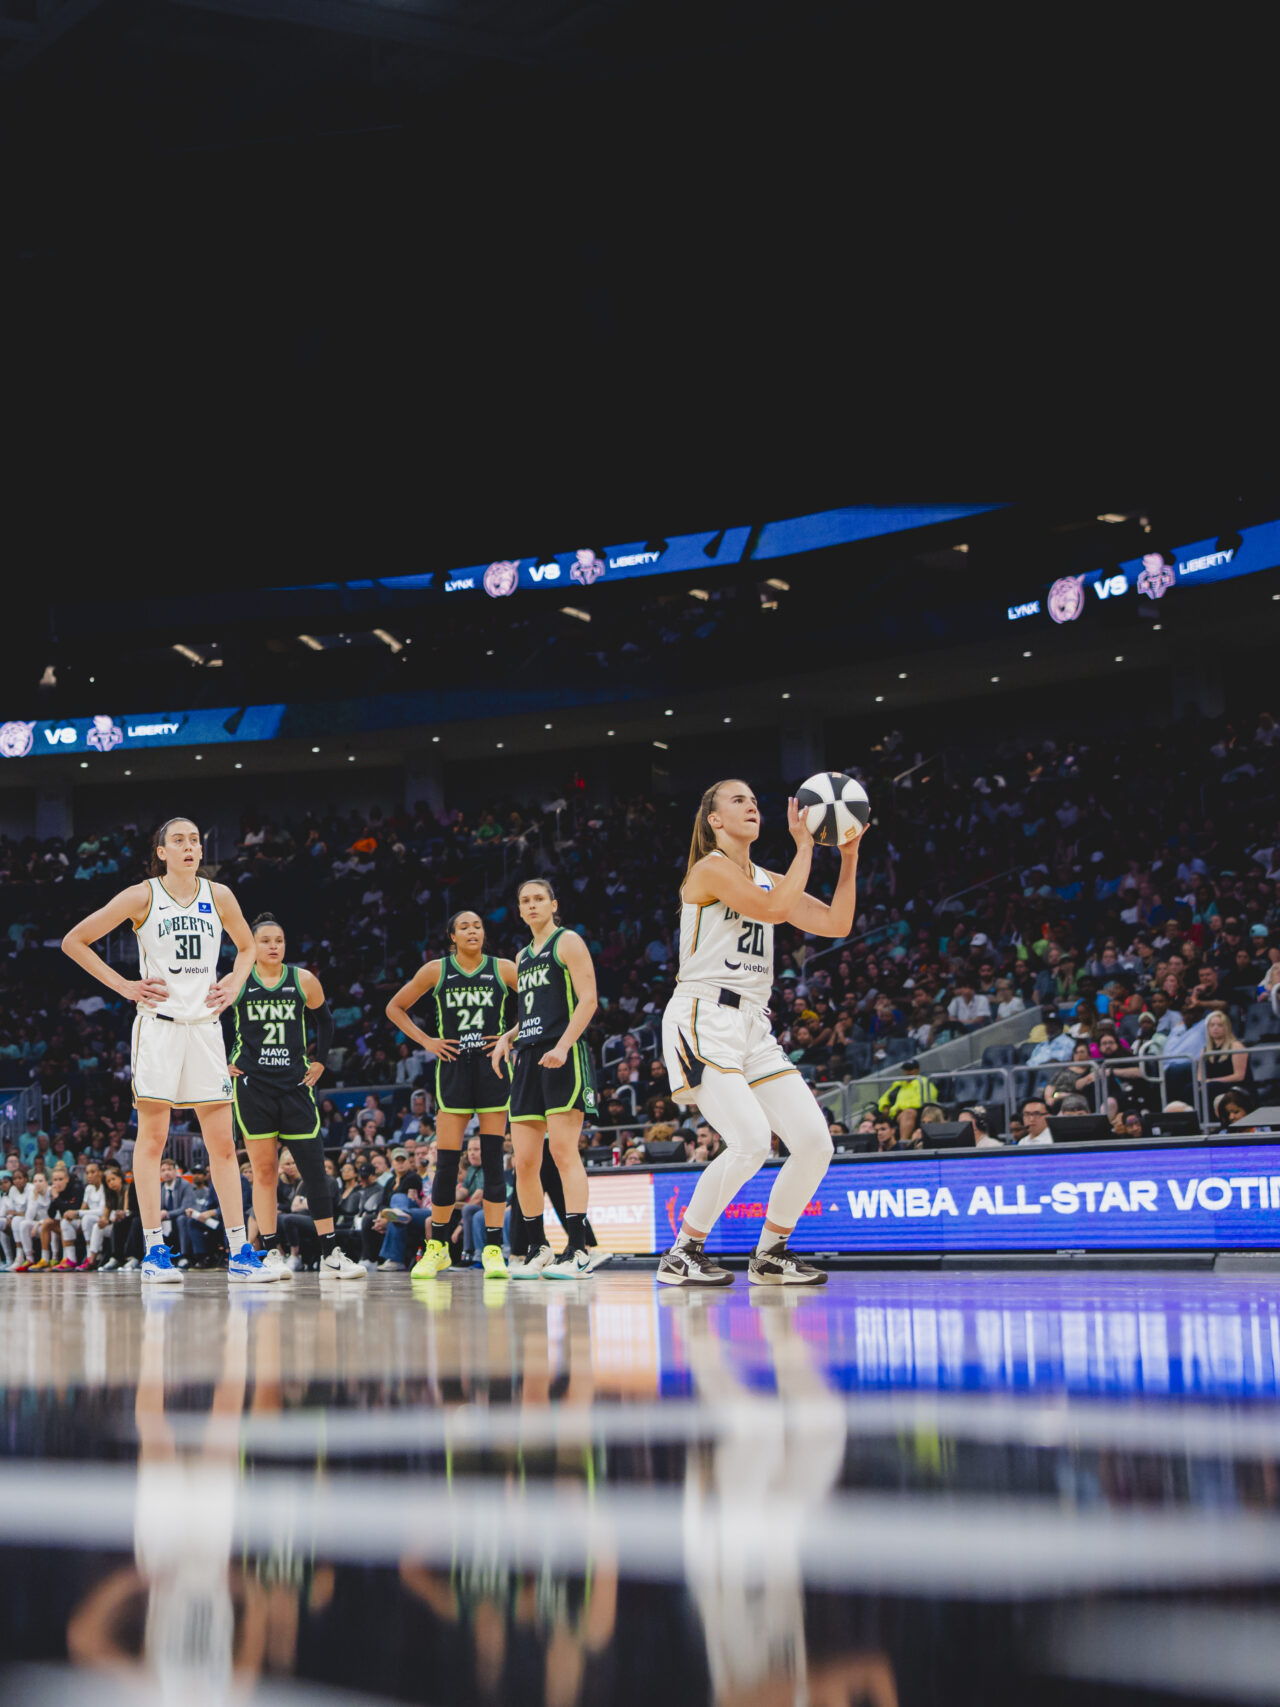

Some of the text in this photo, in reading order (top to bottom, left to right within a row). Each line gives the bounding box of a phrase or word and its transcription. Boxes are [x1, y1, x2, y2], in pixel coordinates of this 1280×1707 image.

[445, 552, 660, 592] LYNX VS LIBERTY
[1007, 549, 1233, 620] LYNX VS LIBERTY
[44, 727, 77, 744] VS
[128, 723, 179, 737] LIBERTY
[158, 916, 214, 938] LIBERTY
[175, 935, 201, 960] 30
[737, 920, 764, 957] 20
[185, 966, 209, 974] Webull
[517, 968, 551, 994] LYNX
[446, 991, 495, 1008] LYNX
[524, 991, 535, 1015] 9
[247, 1004, 296, 1022] LYNX
[457, 1009, 485, 1032] 24
[262, 1022, 286, 1045] 21
[518, 1026, 543, 1039] CLINIC
[258, 1057, 291, 1066] CLINIC
[261, 1048, 289, 1057] MAYO
[847, 1187, 959, 1219] WNBA
[967, 1180, 1158, 1216] ALL-STAR
[592, 1204, 647, 1225] DAILY
